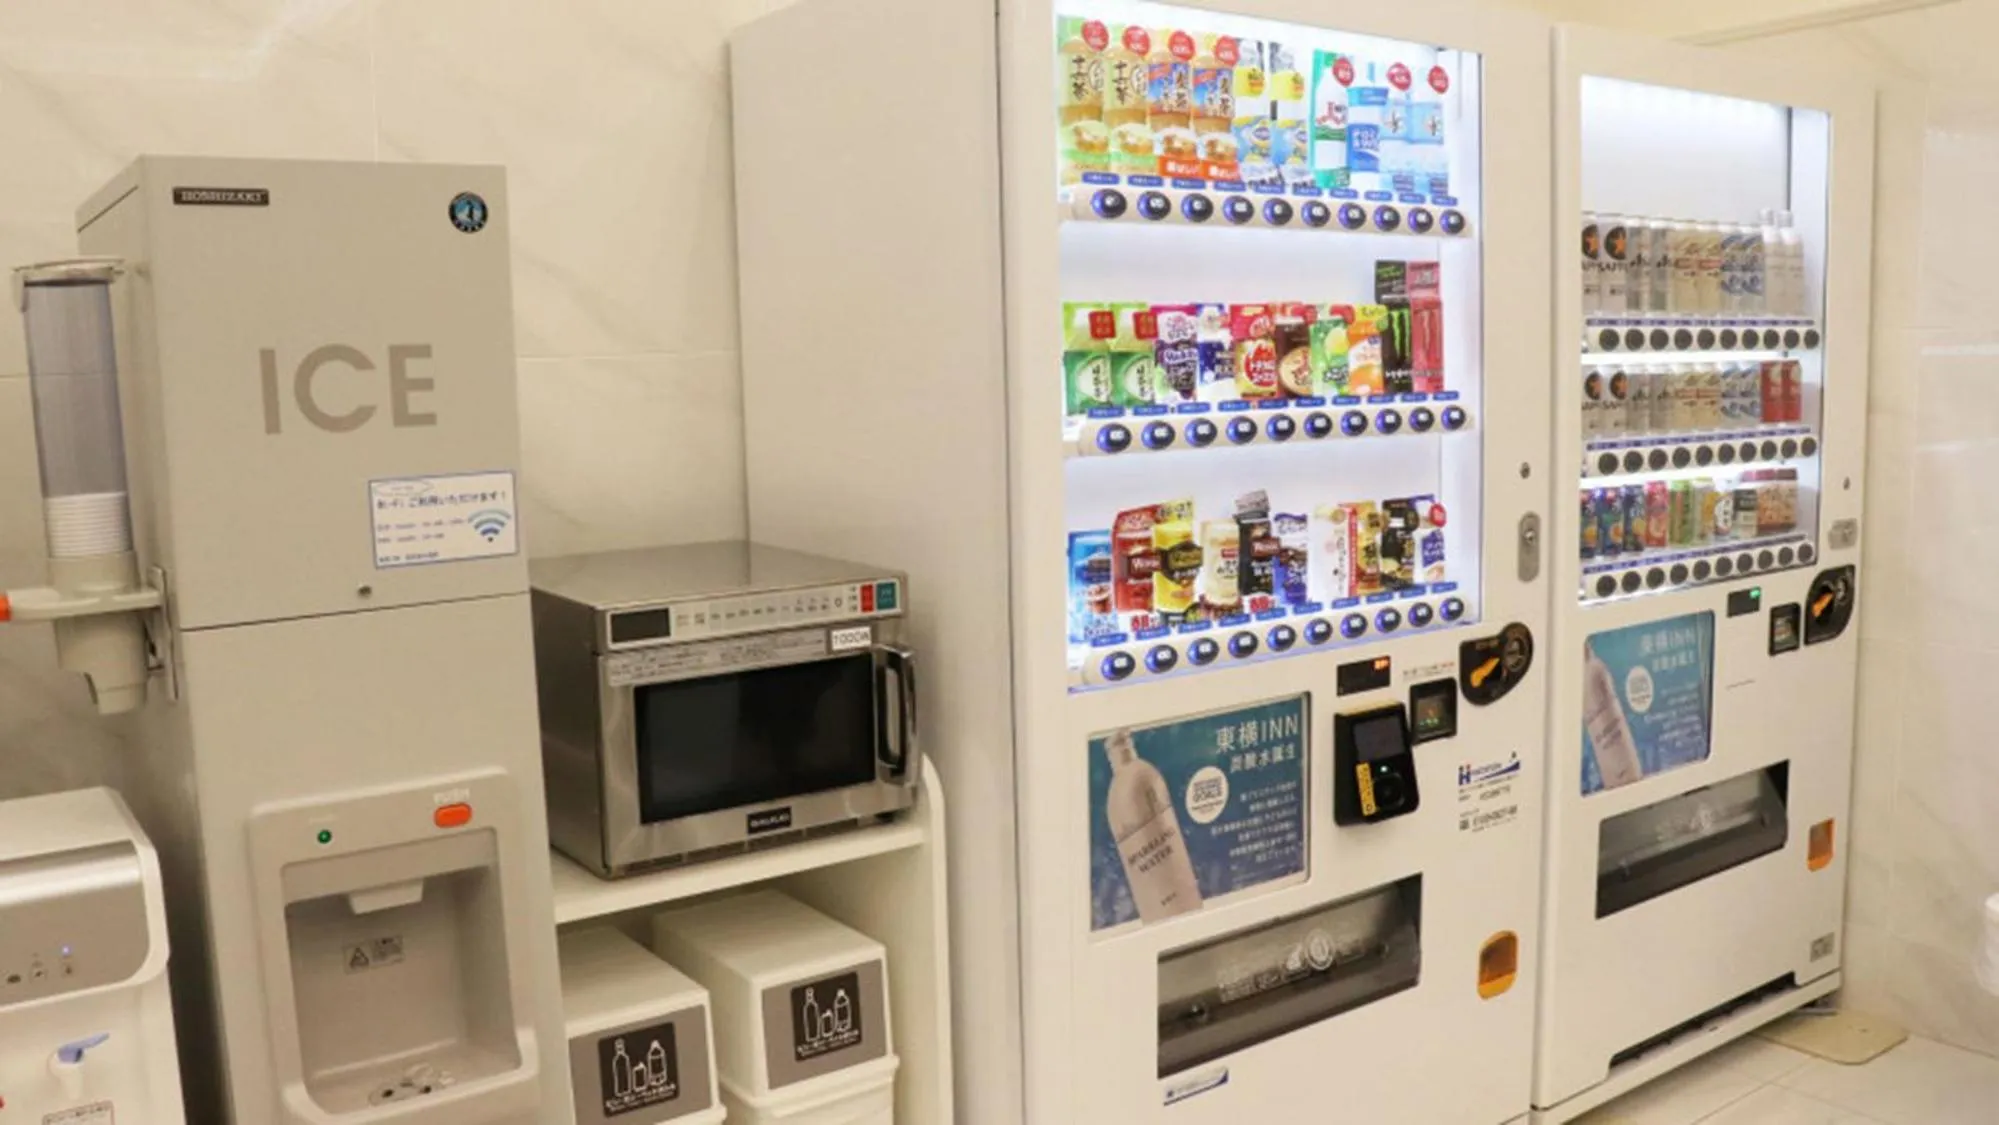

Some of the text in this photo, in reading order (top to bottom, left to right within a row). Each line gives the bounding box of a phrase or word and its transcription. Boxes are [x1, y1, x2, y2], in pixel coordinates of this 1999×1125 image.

[181, 190, 262, 202] HOSHIZAKI
[259, 343, 438, 436] ICE
[1216, 714, 1298, 753] 東横INN
